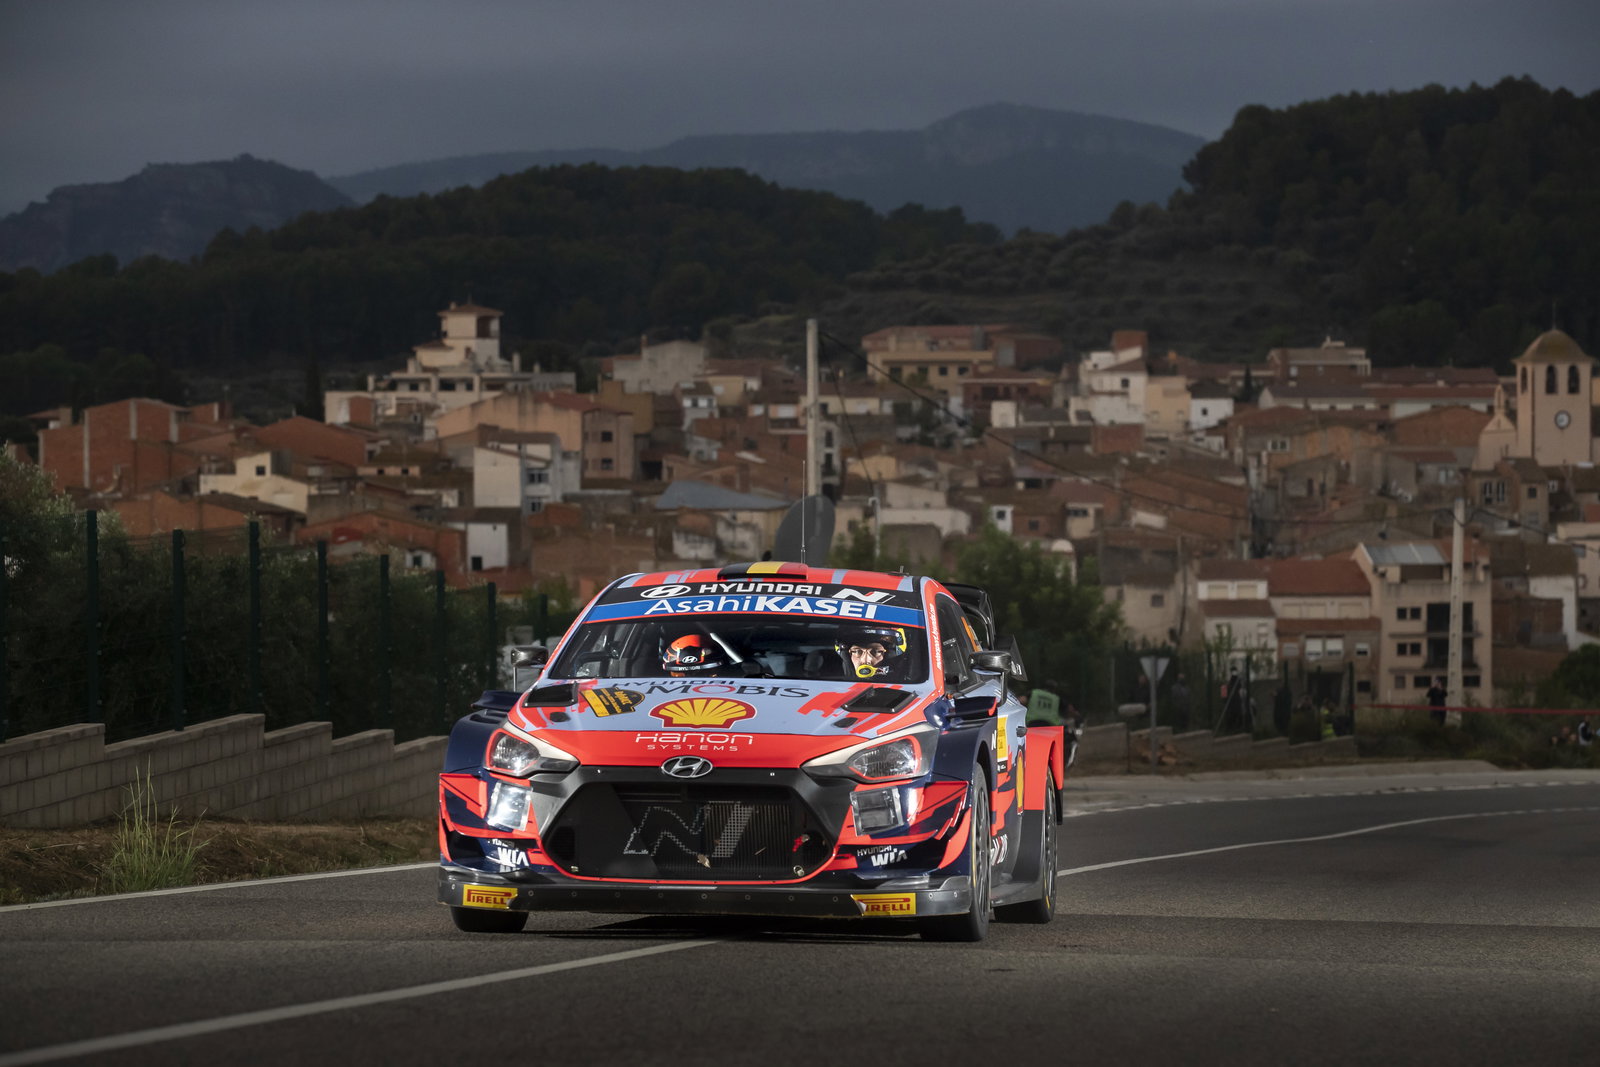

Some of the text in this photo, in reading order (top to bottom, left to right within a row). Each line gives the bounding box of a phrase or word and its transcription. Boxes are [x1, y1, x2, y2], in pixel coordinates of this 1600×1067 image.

[698, 583, 823, 595] HYUNDAI
[644, 596, 878, 619] AsahiKASEI
[612, 680, 736, 688] HYUNDAI
[645, 684, 810, 698] MOBIS
[871, 848, 908, 866] WIA
[467, 889, 512, 906] PIRELL
